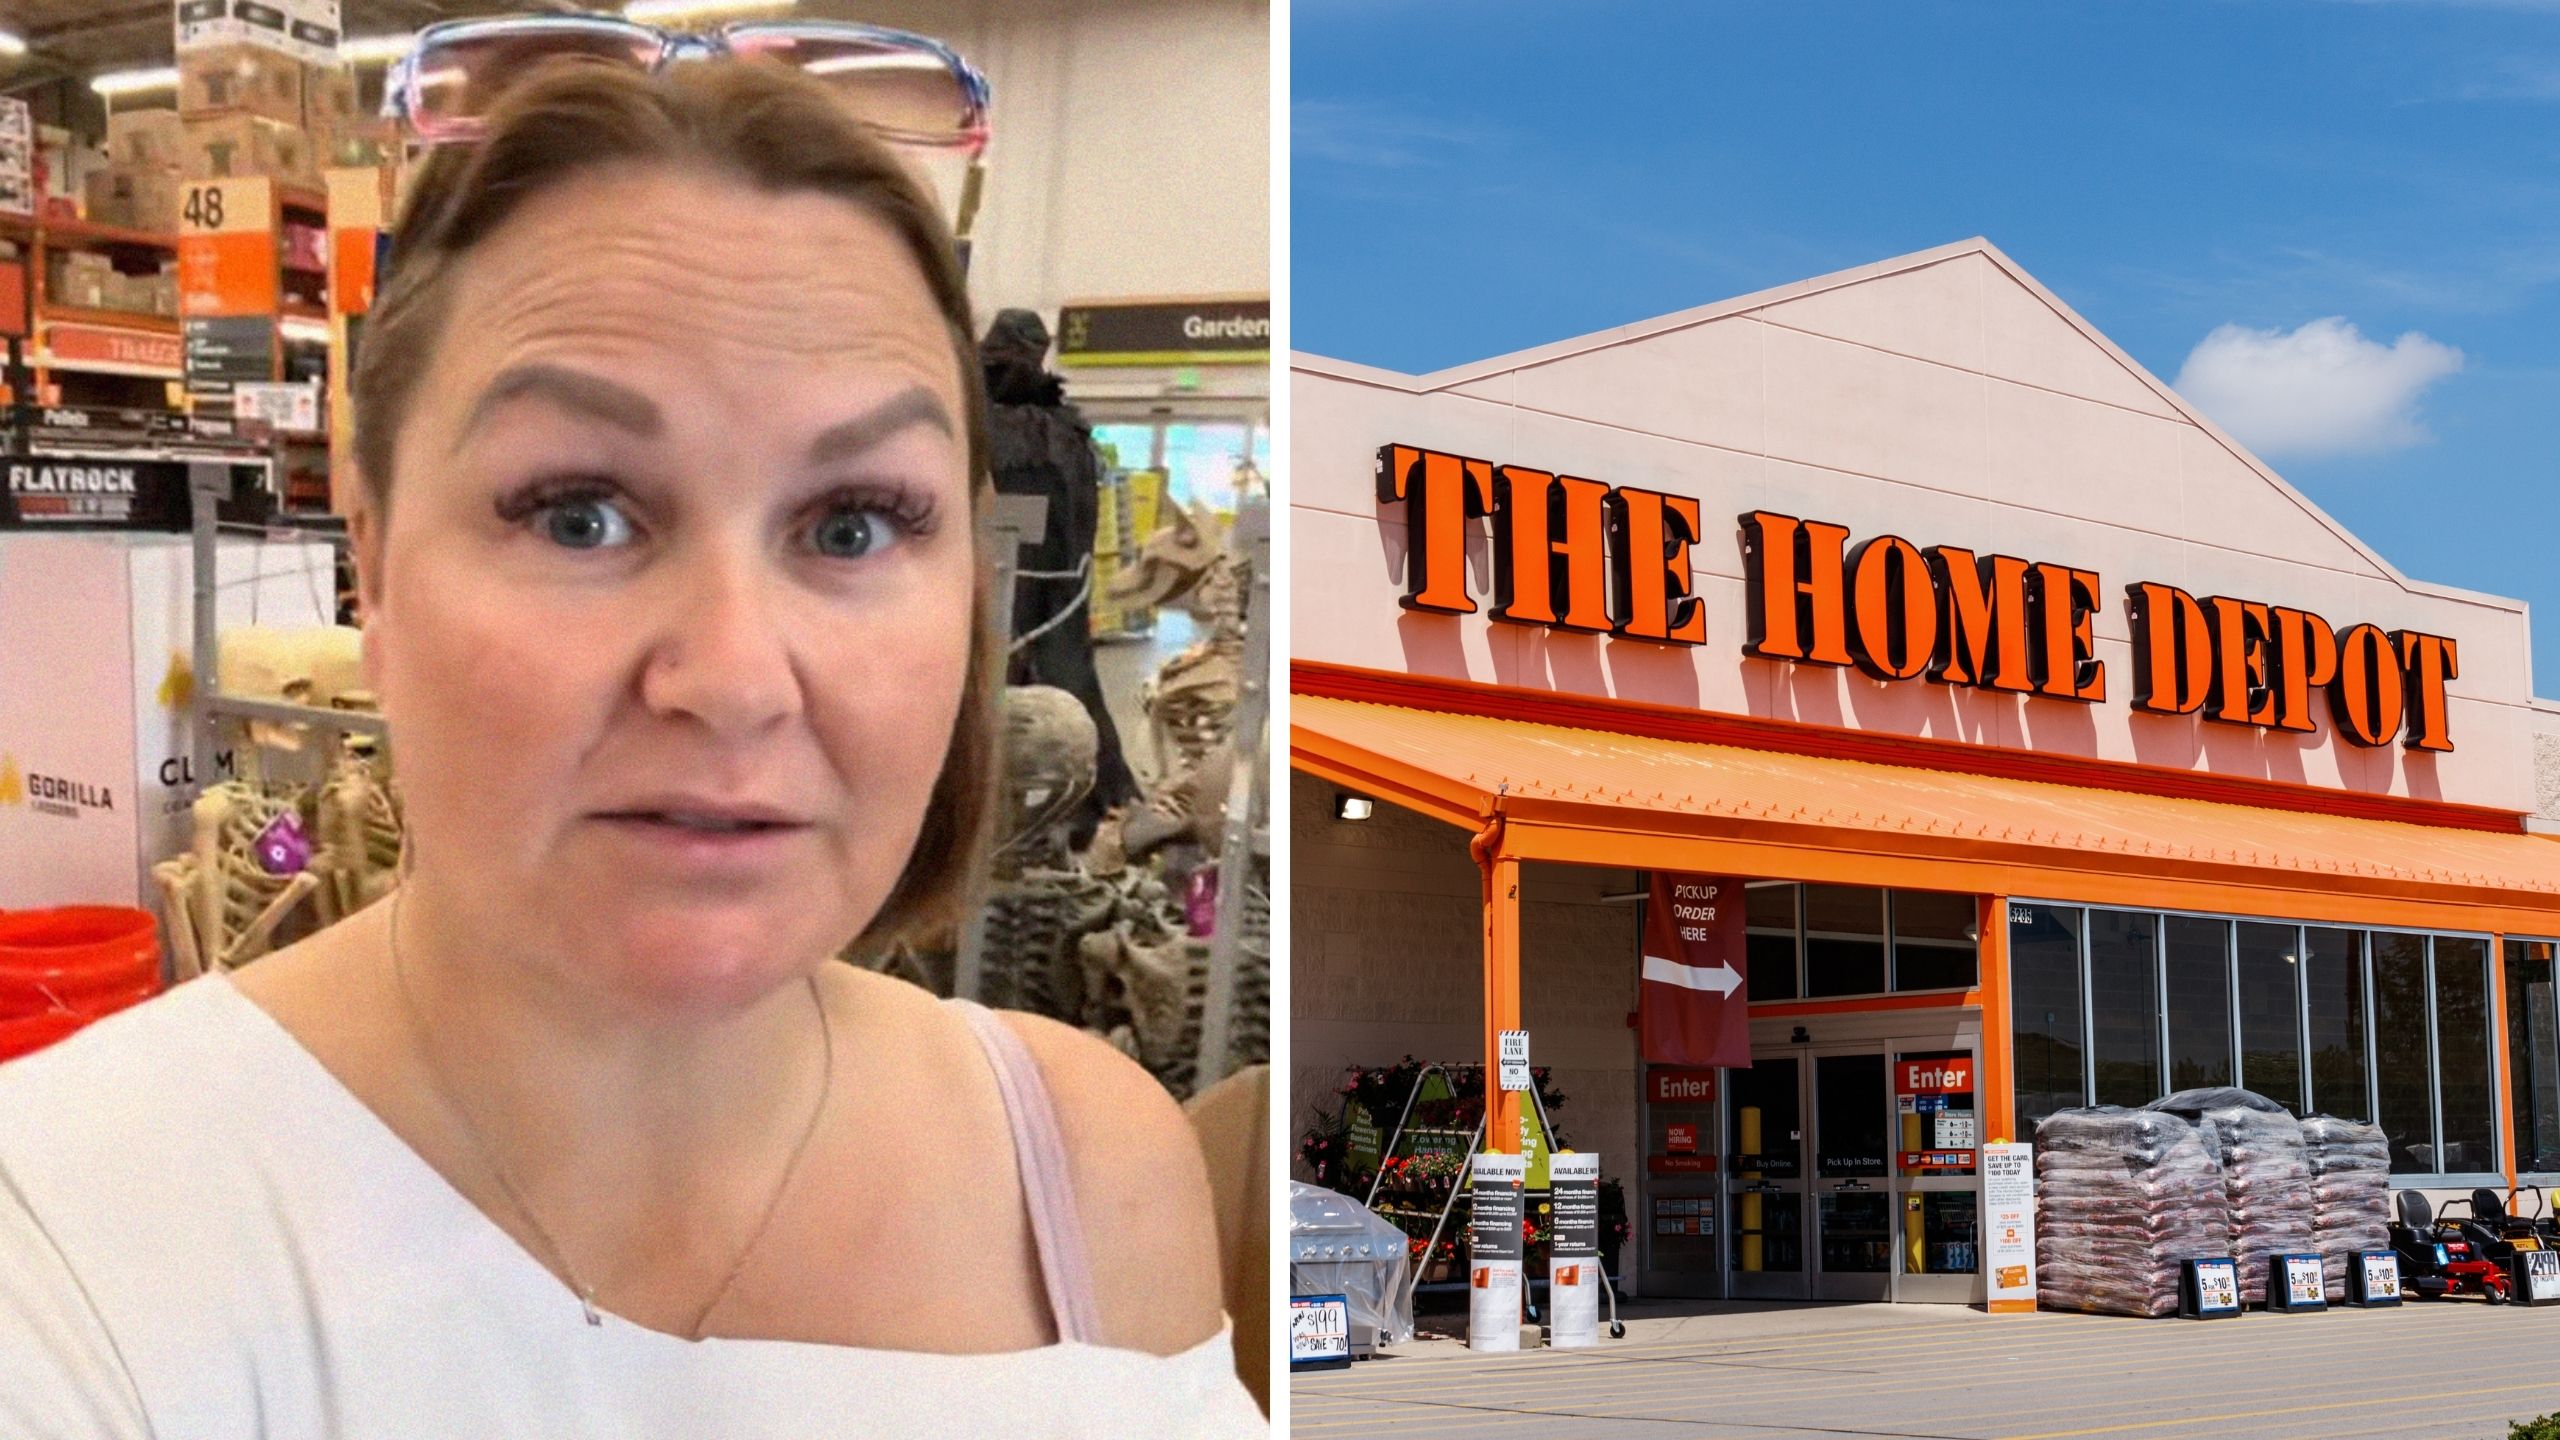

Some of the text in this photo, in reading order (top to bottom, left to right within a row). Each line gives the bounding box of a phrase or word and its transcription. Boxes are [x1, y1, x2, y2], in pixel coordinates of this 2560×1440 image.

[184, 187, 224, 228] 48
[1184, 315, 1270, 339] Garden
[9, 465, 136, 492] FLATROCK
[1376, 443, 2458, 752] THE HOME DEPOT
[160, 749, 233, 786] CLM
[29, 773, 113, 811] GORILLA
[1673, 903, 1716, 921] ORDER
[1679, 925, 1707, 941] HERE
[1505, 1038, 1523, 1047] FIRE
[1504, 1047, 1524, 1056] LANE
[1909, 1065, 1966, 1089] Enter
[1660, 1076, 1710, 1099] Enter
[1668, 1128, 1685, 1136] NOW
[1668, 1136, 1692, 1144] HIRING
[1665, 1159, 1701, 1169] No Smoking
[1756, 1160, 1769, 1168] Buy
[1827, 1157, 1842, 1167] Pick
[1843, 1158, 1853, 1167] Up
[1854, 1157, 1862, 1165] In
[2012, 1154, 2030, 1162] CARD,
[1505, 1168, 1522, 1176] NOW
[1553, 1167, 1589, 1175] AVAILABLE
[1554, 1187, 1563, 1195] 24
[1554, 1202, 1562, 1210] 12
[1554, 1217, 1559, 1225] 6
[2290, 1272, 2297, 1285] 5
[2368, 1269, 2373, 1281] 5
[2201, 1278, 2207, 1290] 5
[1307, 1309, 1337, 1334] $199
[1310, 1337, 1327, 1351] SAVE
